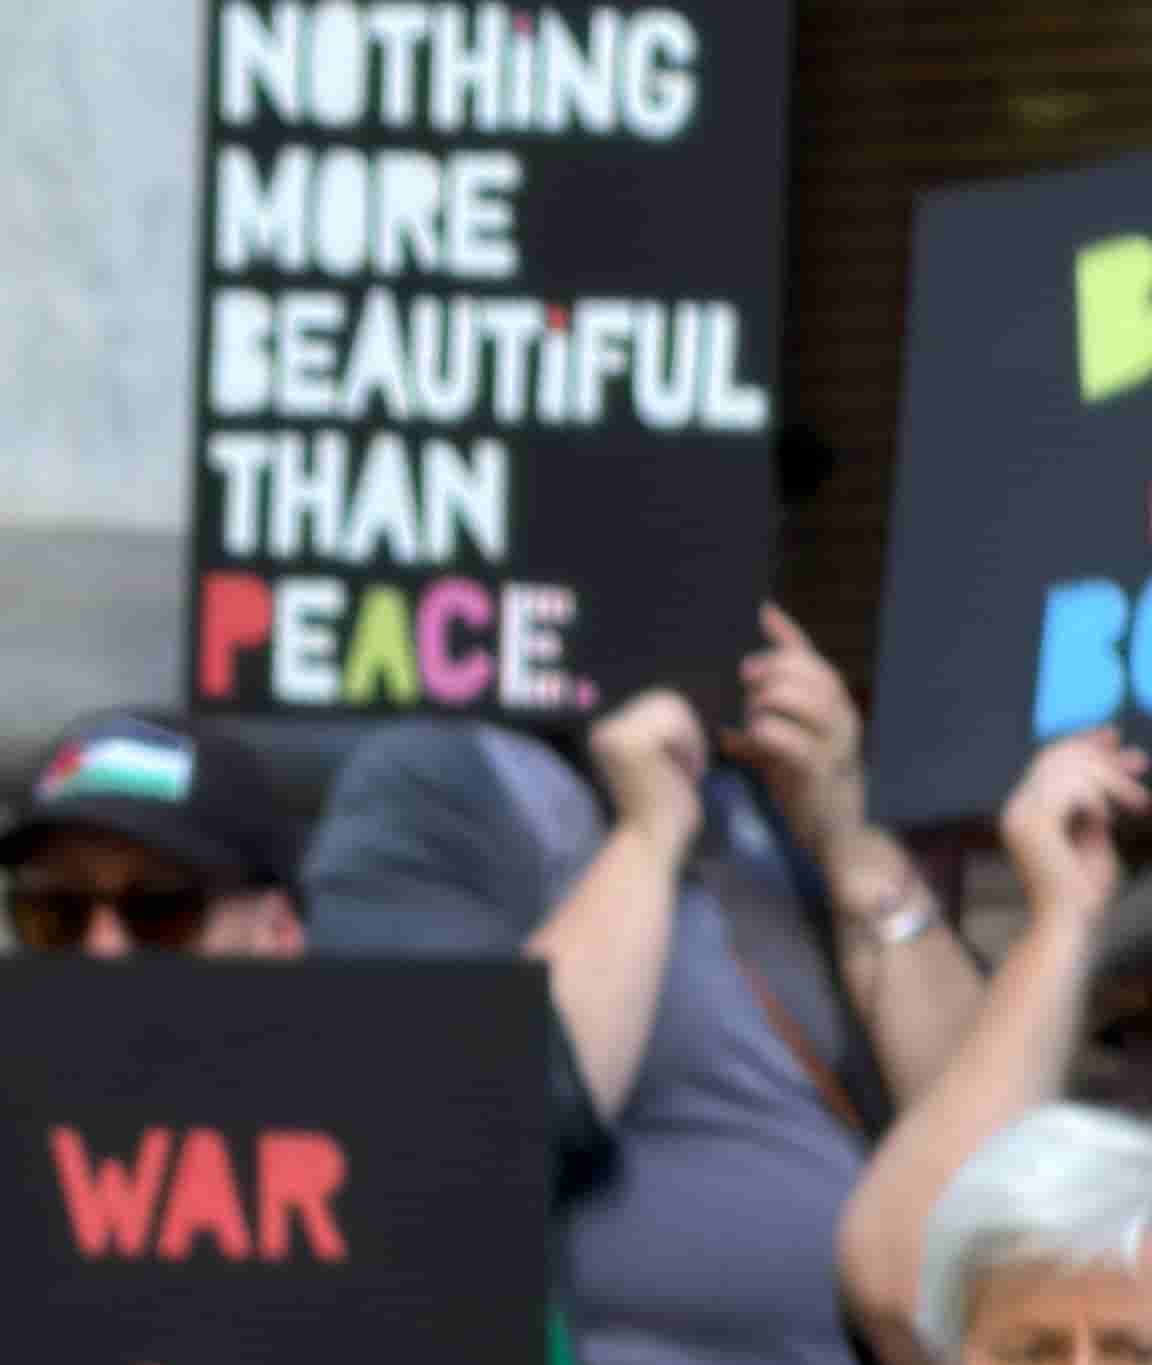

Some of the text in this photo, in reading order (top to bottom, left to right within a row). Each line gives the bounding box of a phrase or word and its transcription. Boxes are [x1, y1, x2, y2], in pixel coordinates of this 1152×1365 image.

[215, 144, 524, 278] MORE
[208, 430, 510, 565] THAN
[198, 572, 598, 710] PEACE.
[51, 1124, 349, 1263] WAR
